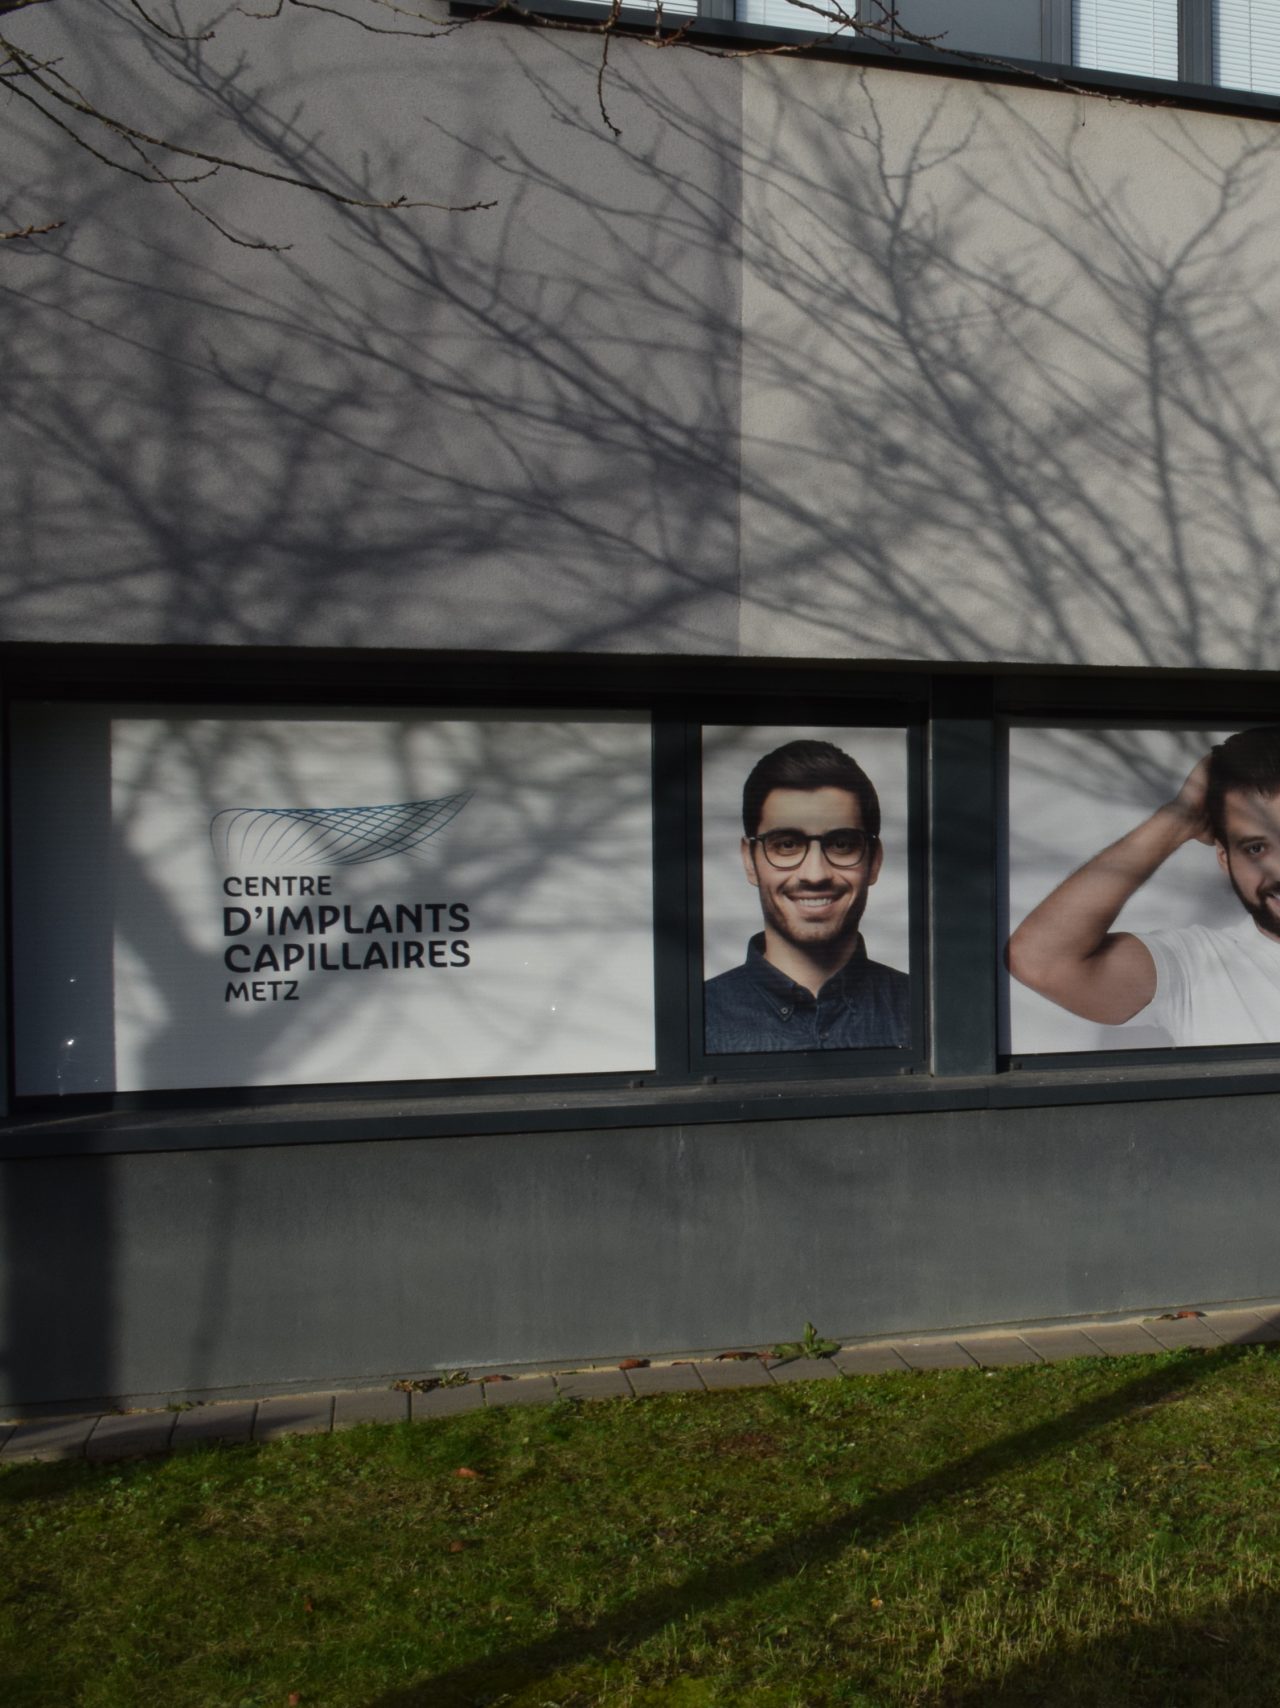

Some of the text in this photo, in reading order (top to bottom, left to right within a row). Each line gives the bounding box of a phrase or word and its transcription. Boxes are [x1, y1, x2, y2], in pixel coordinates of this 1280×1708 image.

[223, 876, 332, 897] CENTRE
[223, 903, 470, 936] D'IMPLANTS
[224, 940, 471, 973] CAPILLAIRES
[225, 981, 299, 1002] METZ
